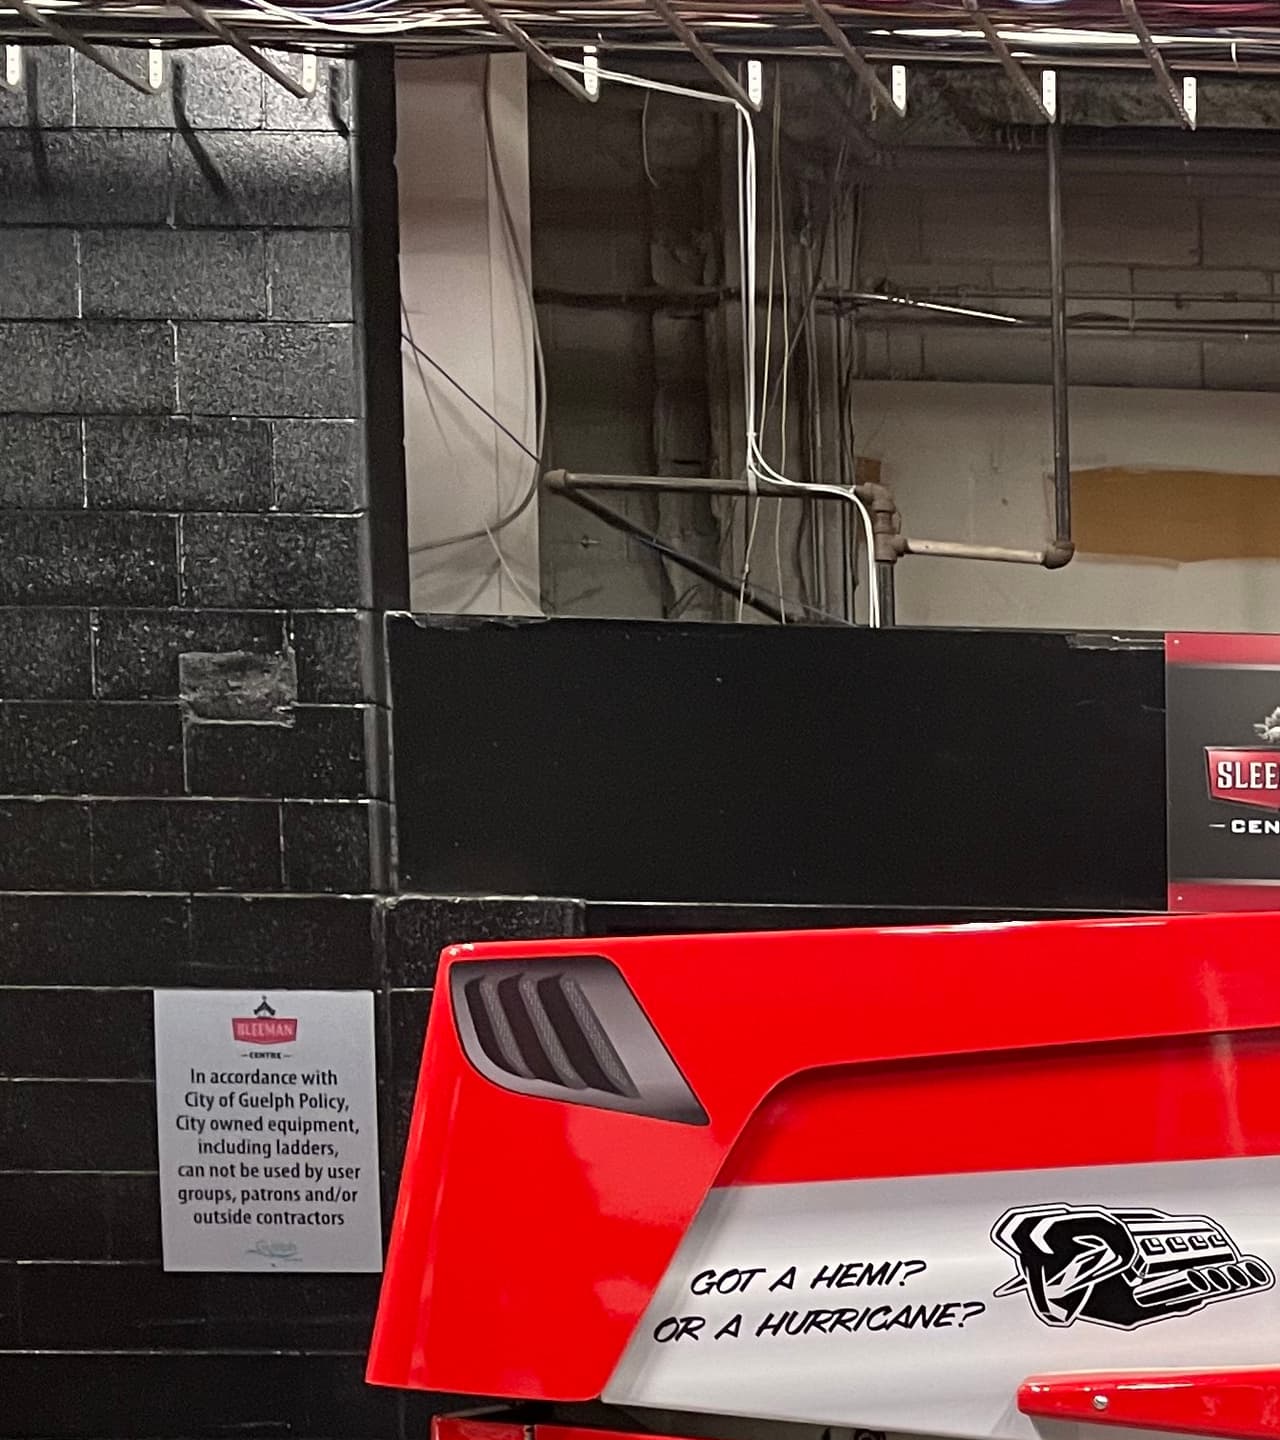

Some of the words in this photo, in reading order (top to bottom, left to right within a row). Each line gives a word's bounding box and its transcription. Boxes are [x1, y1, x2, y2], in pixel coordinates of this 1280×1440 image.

[190, 1068, 206, 1085] In
[210, 1068, 297, 1085] accordance
[301, 1069, 338, 1086] with
[184, 1091, 215, 1112] City
[218, 1091, 236, 1108] of
[238, 1092, 295, 1112] Guelph
[299, 1093, 350, 1113] Policy,
[175, 1114, 206, 1135] City
[210, 1115, 264, 1132] owned
[267, 1116, 360, 1135] equipment,
[197, 1138, 272, 1158] including
[276, 1139, 340, 1158] ladders,
[177, 1164, 205, 1178] can
[209, 1163, 236, 1178] not
[240, 1162, 260, 1179] be
[263, 1163, 301, 1179] used
[304, 1163, 323, 1182] by
[327, 1166, 361, 1180] user
[177, 1187, 236, 1205] groups,
[240, 1187, 301, 1205] patrons
[304, 1186, 359, 1203] and/or
[193, 1208, 252, 1225] outside
[256, 1210, 345, 1226] contractors
[690, 1265, 768, 1297] GOT
[773, 1263, 798, 1292] A
[811, 1259, 928, 1291] HEMI?
[653, 1313, 706, 1345] OR
[715, 1311, 744, 1342] A
[755, 1301, 987, 1339] HURRICANE?
